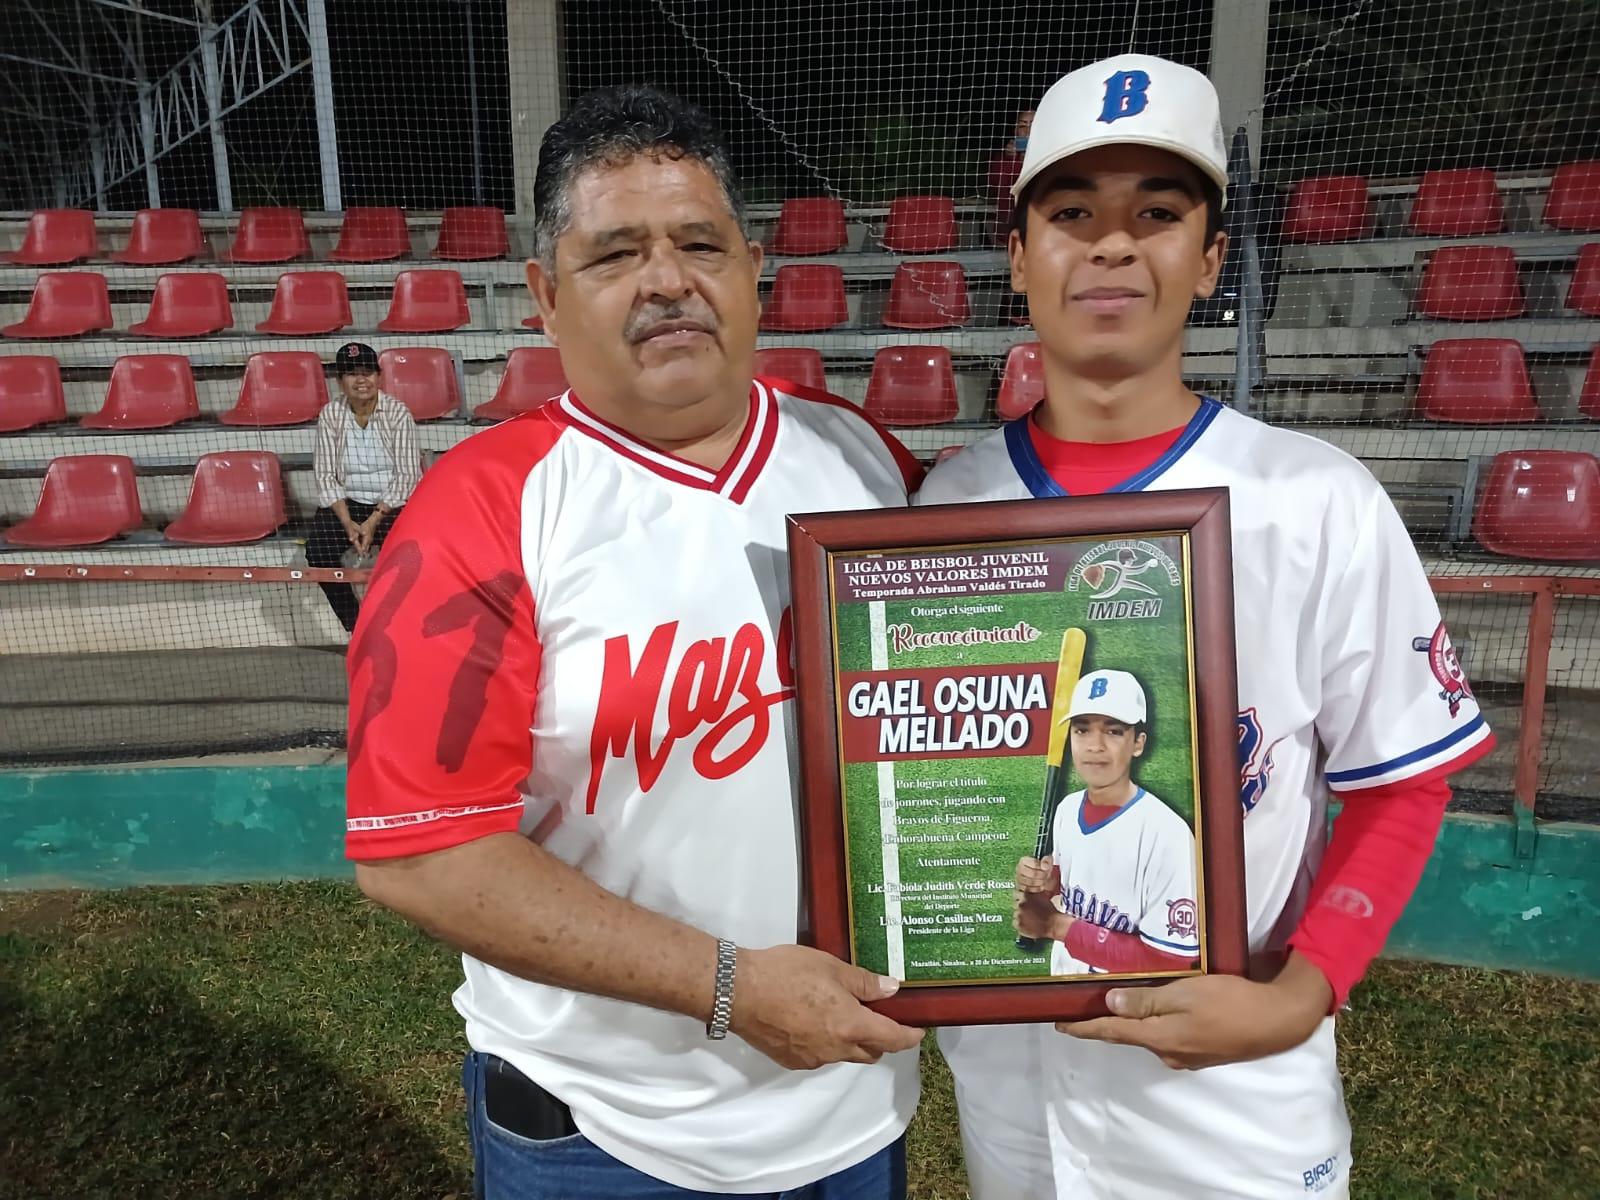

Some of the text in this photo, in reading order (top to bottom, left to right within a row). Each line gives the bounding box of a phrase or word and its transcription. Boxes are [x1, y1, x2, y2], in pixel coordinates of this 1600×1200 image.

[1096, 70, 1151, 124] B
[844, 552, 1049, 574] LIGA DE BEISBOL JUVENIL
[849, 565, 1048, 586] NUEVOS VALORES IMDEM
[852, 580, 1046, 599] Temporada Abraham Valdés Tirado
[911, 603, 1004, 617] Otorga el siguiente
[1088, 598, 1162, 620] IMDEM
[848, 674, 1048, 717] GAEL OSUNA
[1088, 677, 1109, 700] B
[879, 712, 1029, 753] MELLADO
[896, 780, 914, 789] Por
[916, 779, 948, 790] lograr
[950, 777, 958, 787] el
[944, 795, 986, 807] jugando
[987, 796, 1006, 804] con
[893, 816, 929, 825] Bravos
[931, 815, 943, 824] de
[916, 857, 981, 868] Atentamente
[924, 881, 955, 891] Judith
[956, 880, 986, 890] Verde
[987, 880, 1016, 889] Rosas
[902, 915, 934, 925] Alonso
[936, 914, 974, 923] Casillas
[975, 913, 1003, 922] Meza
[1176, 910, 1193, 925] 30
[1303, 1153, 1338, 1186] BIRD
